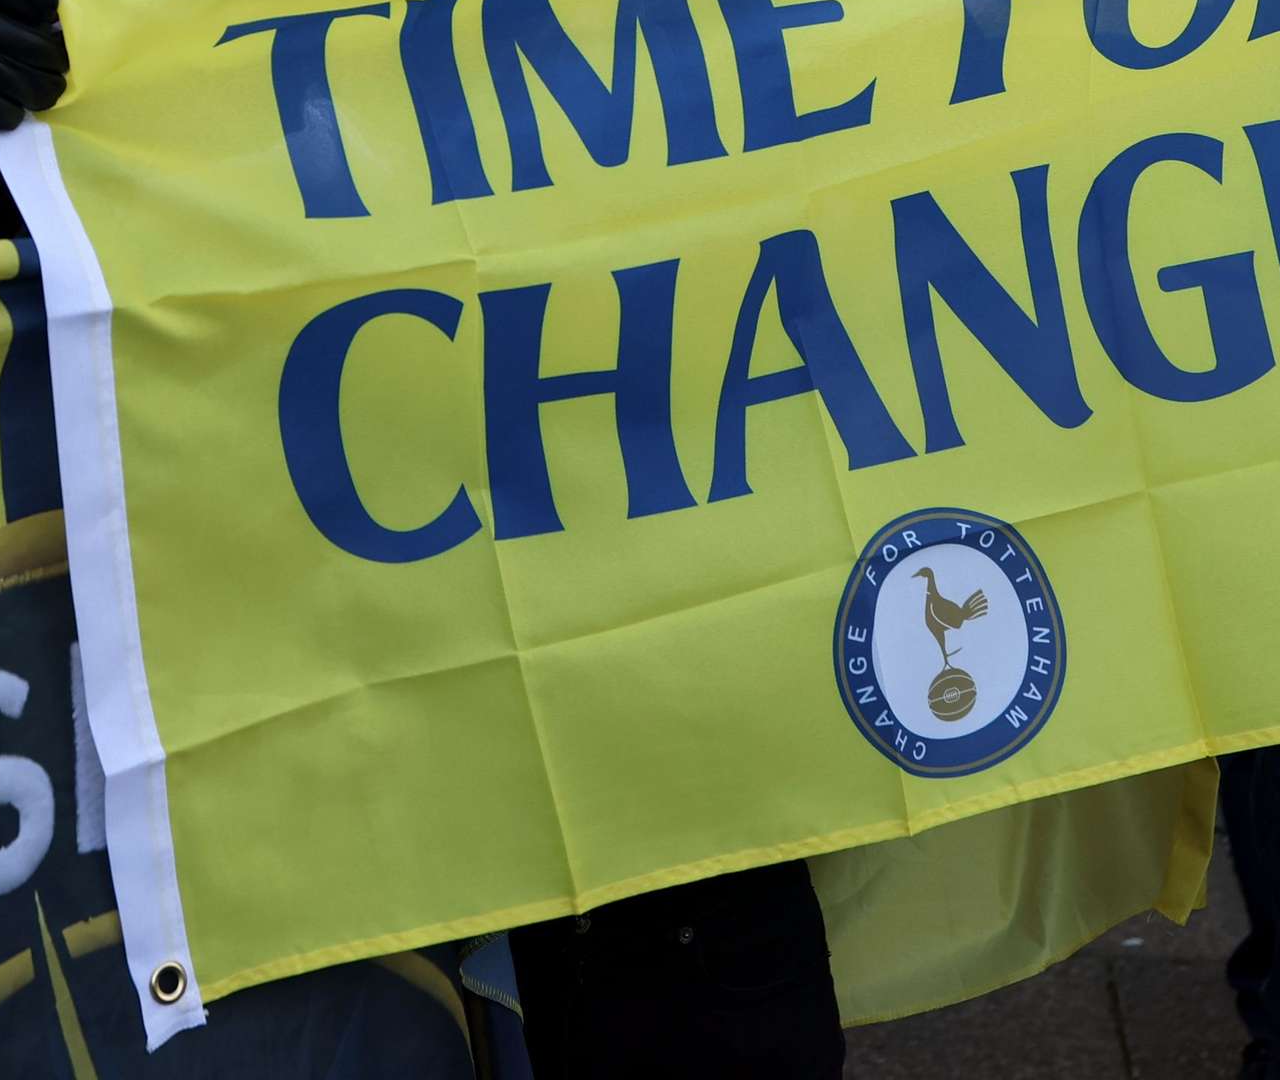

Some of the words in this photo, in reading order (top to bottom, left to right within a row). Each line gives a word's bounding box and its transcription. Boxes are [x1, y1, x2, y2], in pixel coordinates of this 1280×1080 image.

[865, 530, 922, 587] FOR
[955, 521, 1051, 729] TOTTENHAM
[847, 624, 927, 761] CHANGE
